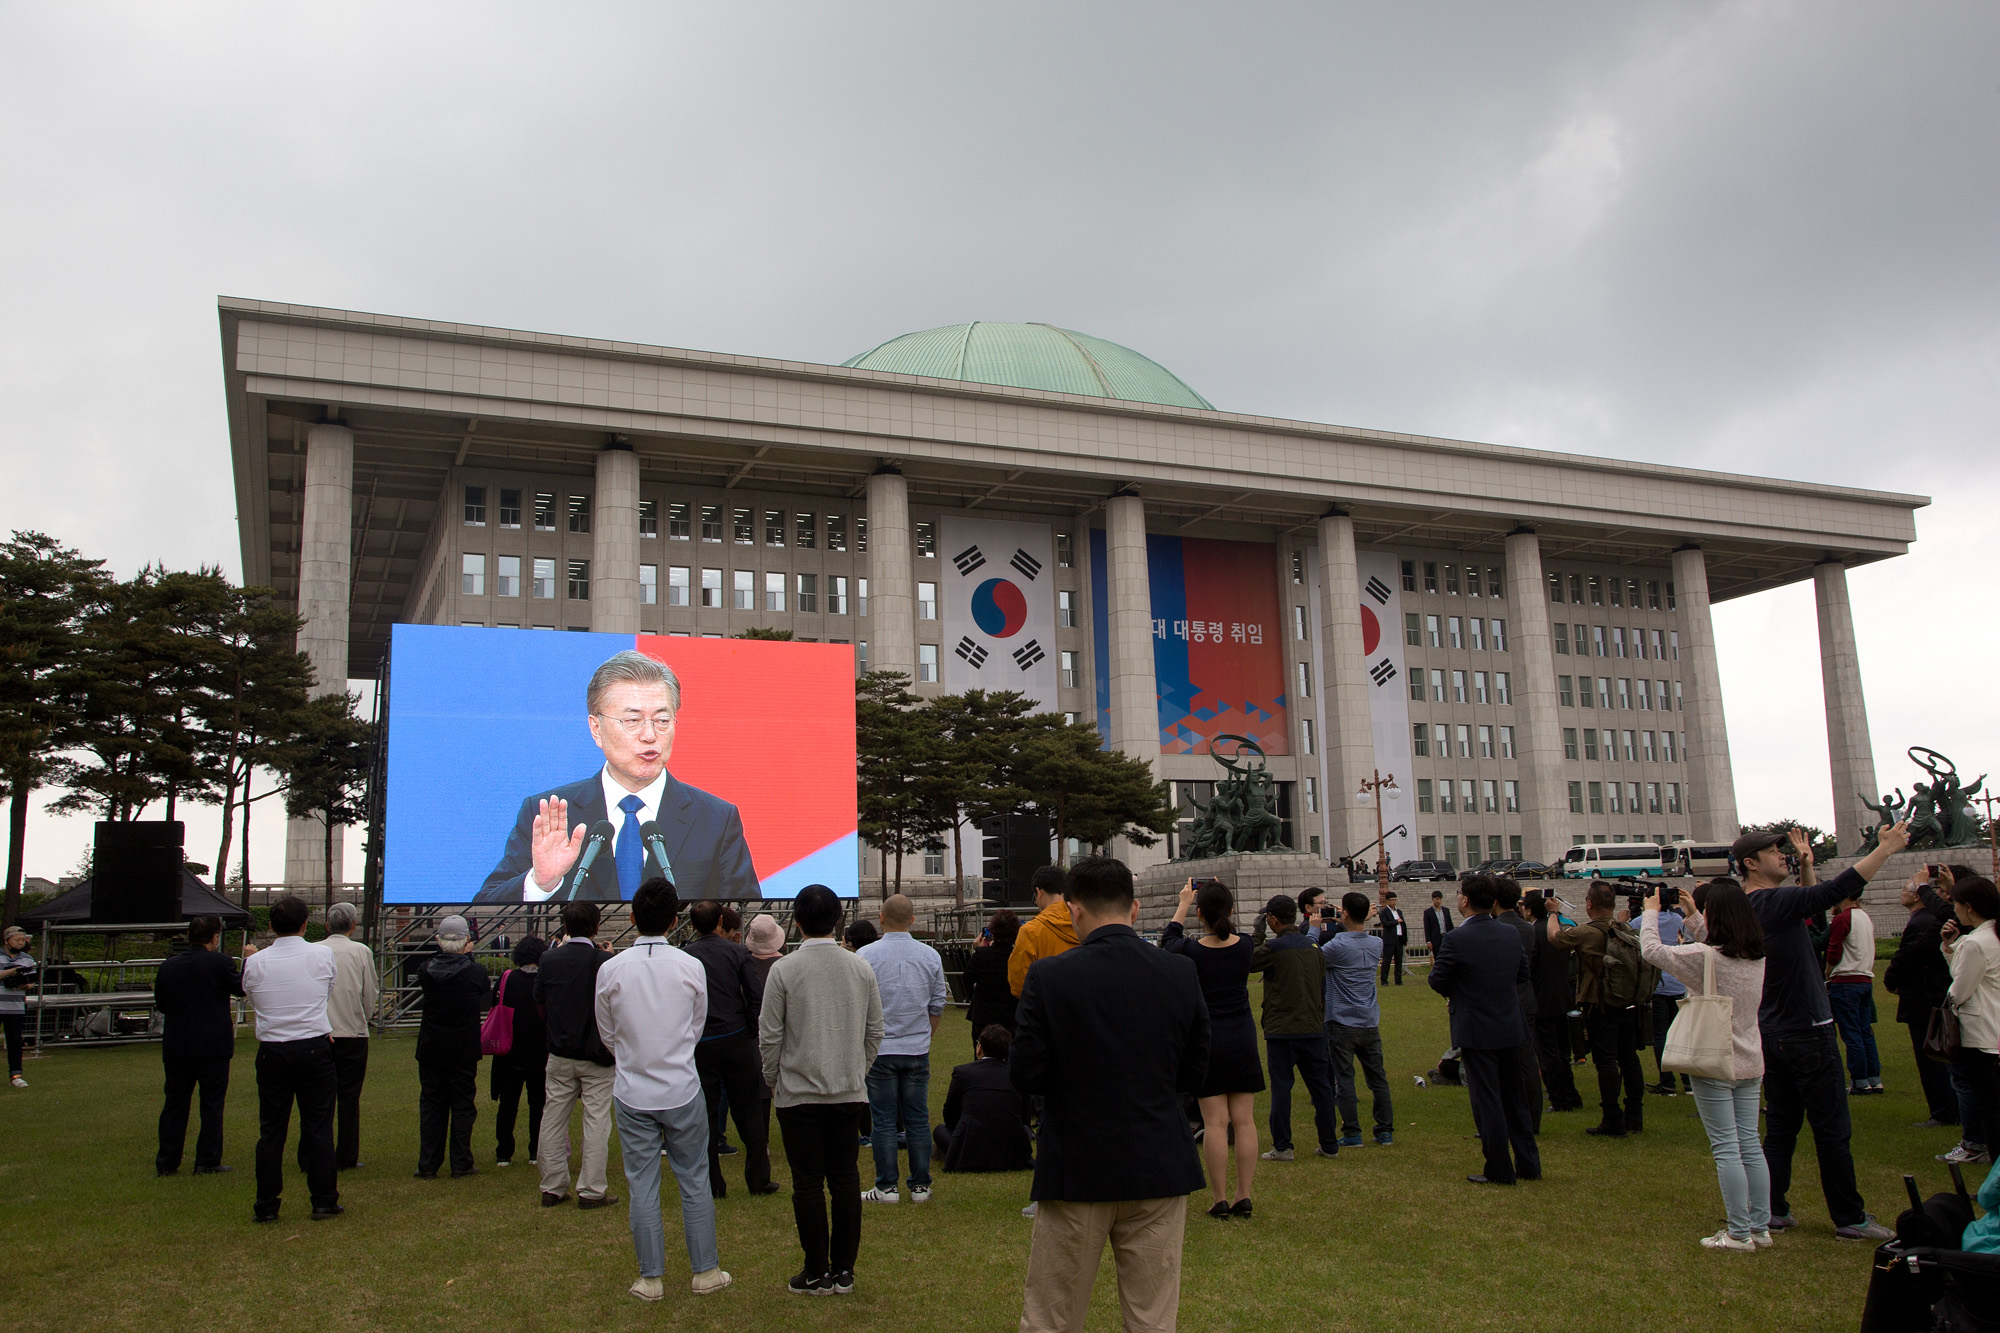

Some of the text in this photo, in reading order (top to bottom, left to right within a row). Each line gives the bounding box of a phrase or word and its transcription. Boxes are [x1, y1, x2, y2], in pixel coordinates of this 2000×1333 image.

[1152, 619, 1262, 644] 대 대통령 취임
